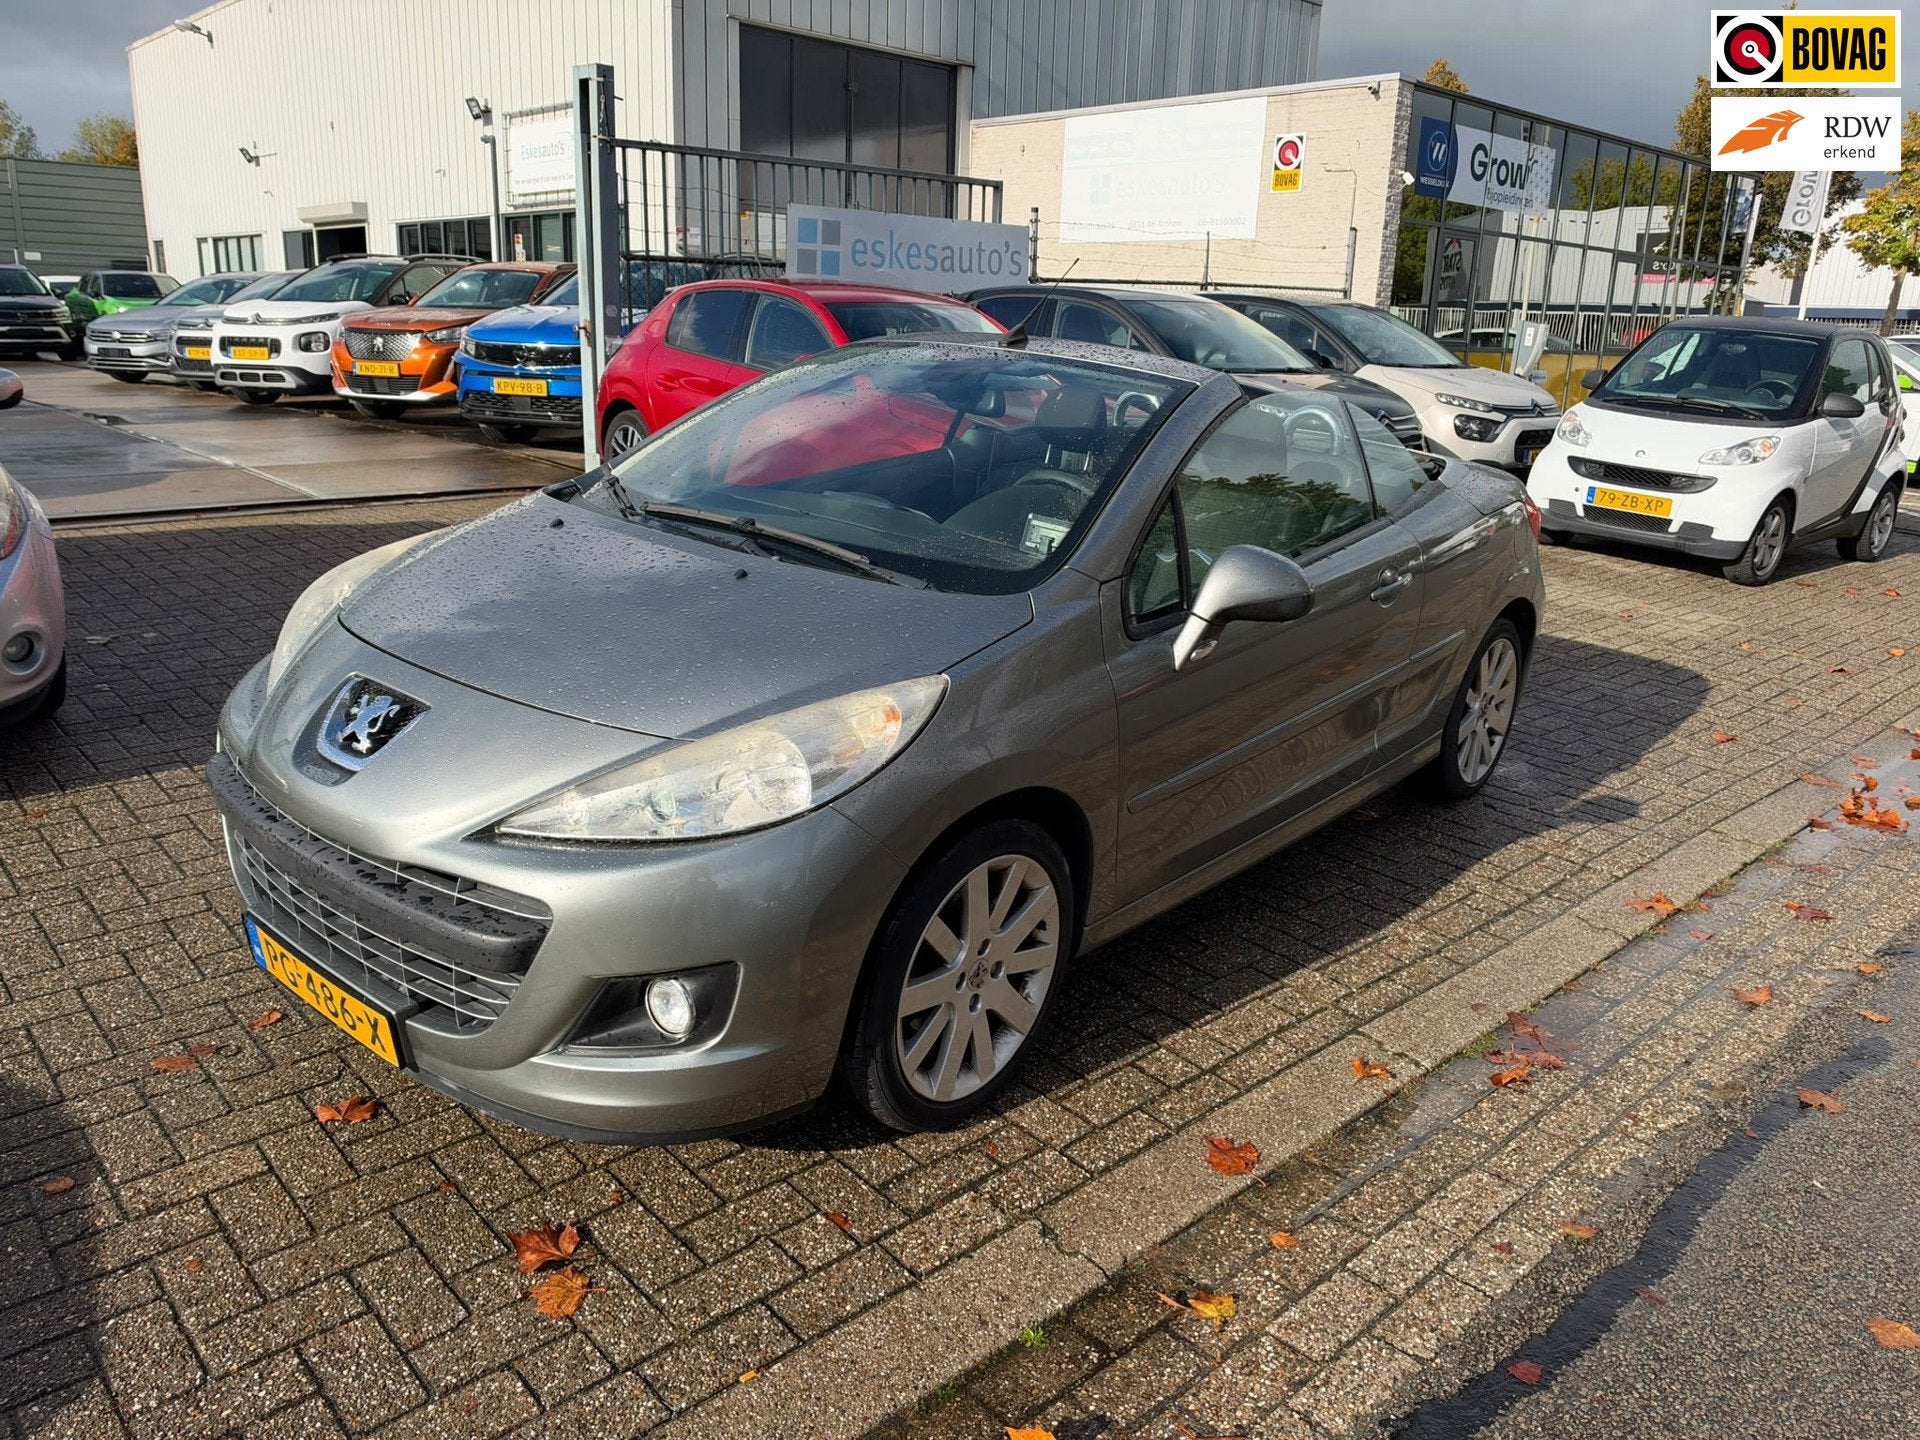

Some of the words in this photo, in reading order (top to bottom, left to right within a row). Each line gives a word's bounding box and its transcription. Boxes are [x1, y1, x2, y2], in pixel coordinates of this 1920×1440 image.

[1471, 143, 1528, 190] Grow
[1275, 173, 1298, 187] BOVAG
[852, 230, 1022, 276] eskesauto's
[359, 364, 395, 372] KND-31-R
[497, 381, 543, 394] KPV-98-B
[1600, 491, 1664, 512] 79-ZB-XP
[264, 938, 387, 1054] PG-486-X
